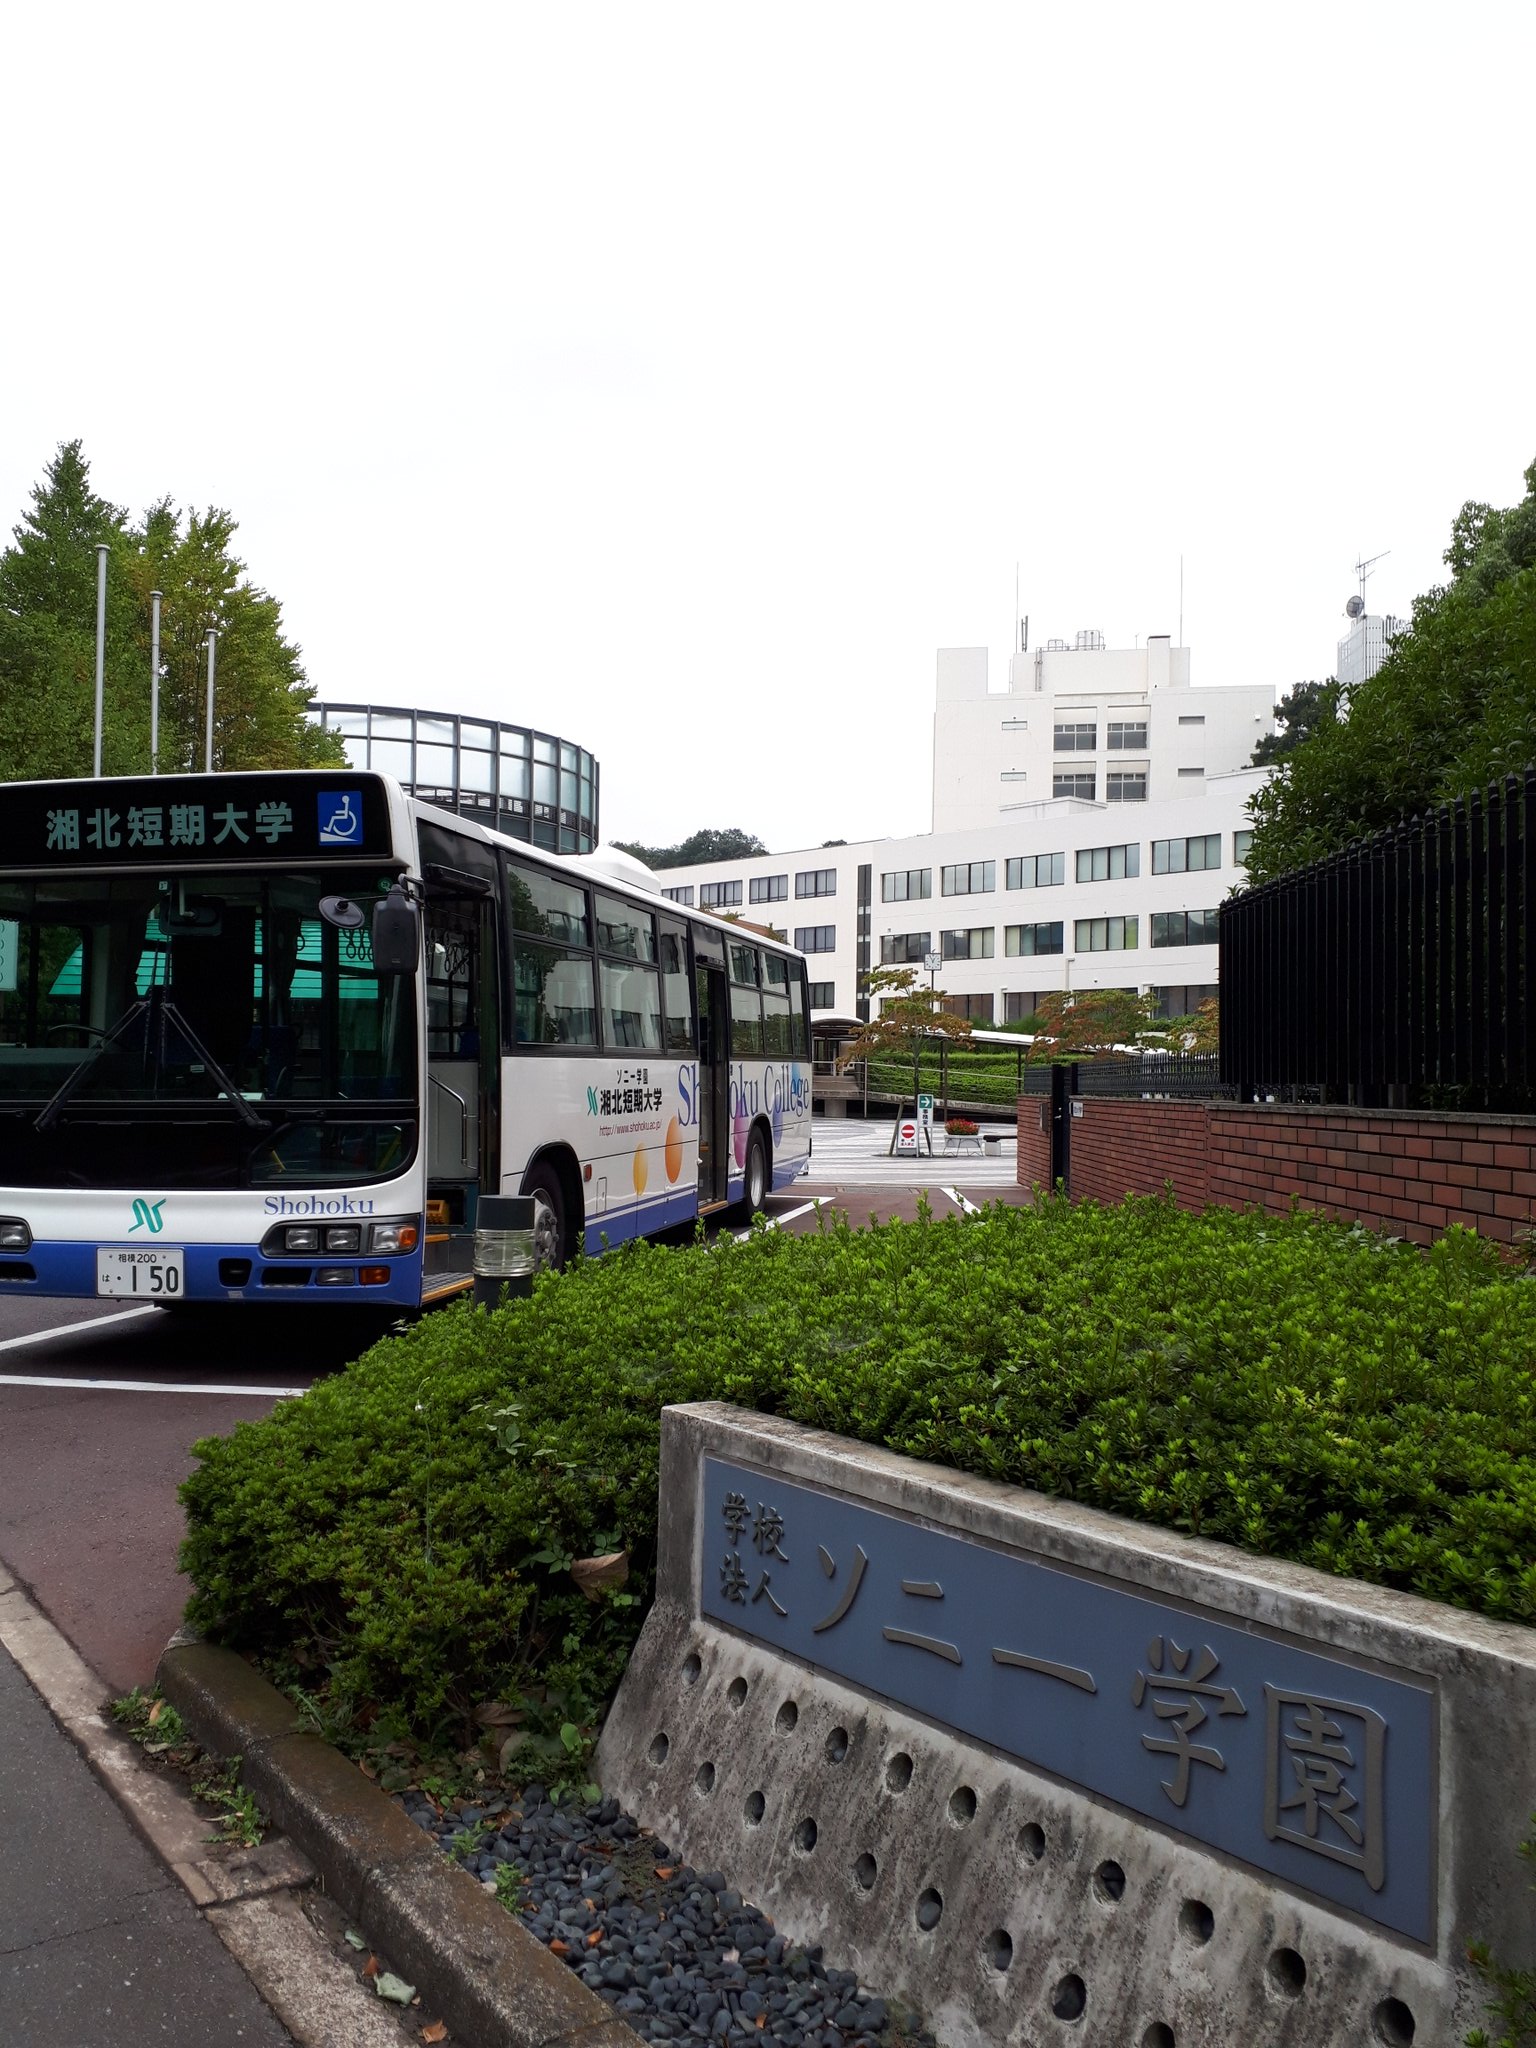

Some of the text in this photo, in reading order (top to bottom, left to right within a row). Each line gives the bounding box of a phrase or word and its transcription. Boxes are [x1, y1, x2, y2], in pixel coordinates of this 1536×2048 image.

[46, 801, 293, 850] 湘北短期大学
[616, 1068, 648, 1085] ソニー学園
[600, 1087, 662, 1116] 湘北短期大学
[677, 1062, 809, 1127] Shoku College
[264, 1195, 375, 1216] Shohoku
[102, 1274, 110, 1282] は
[812, 1543, 1388, 1892] ソニー学園
